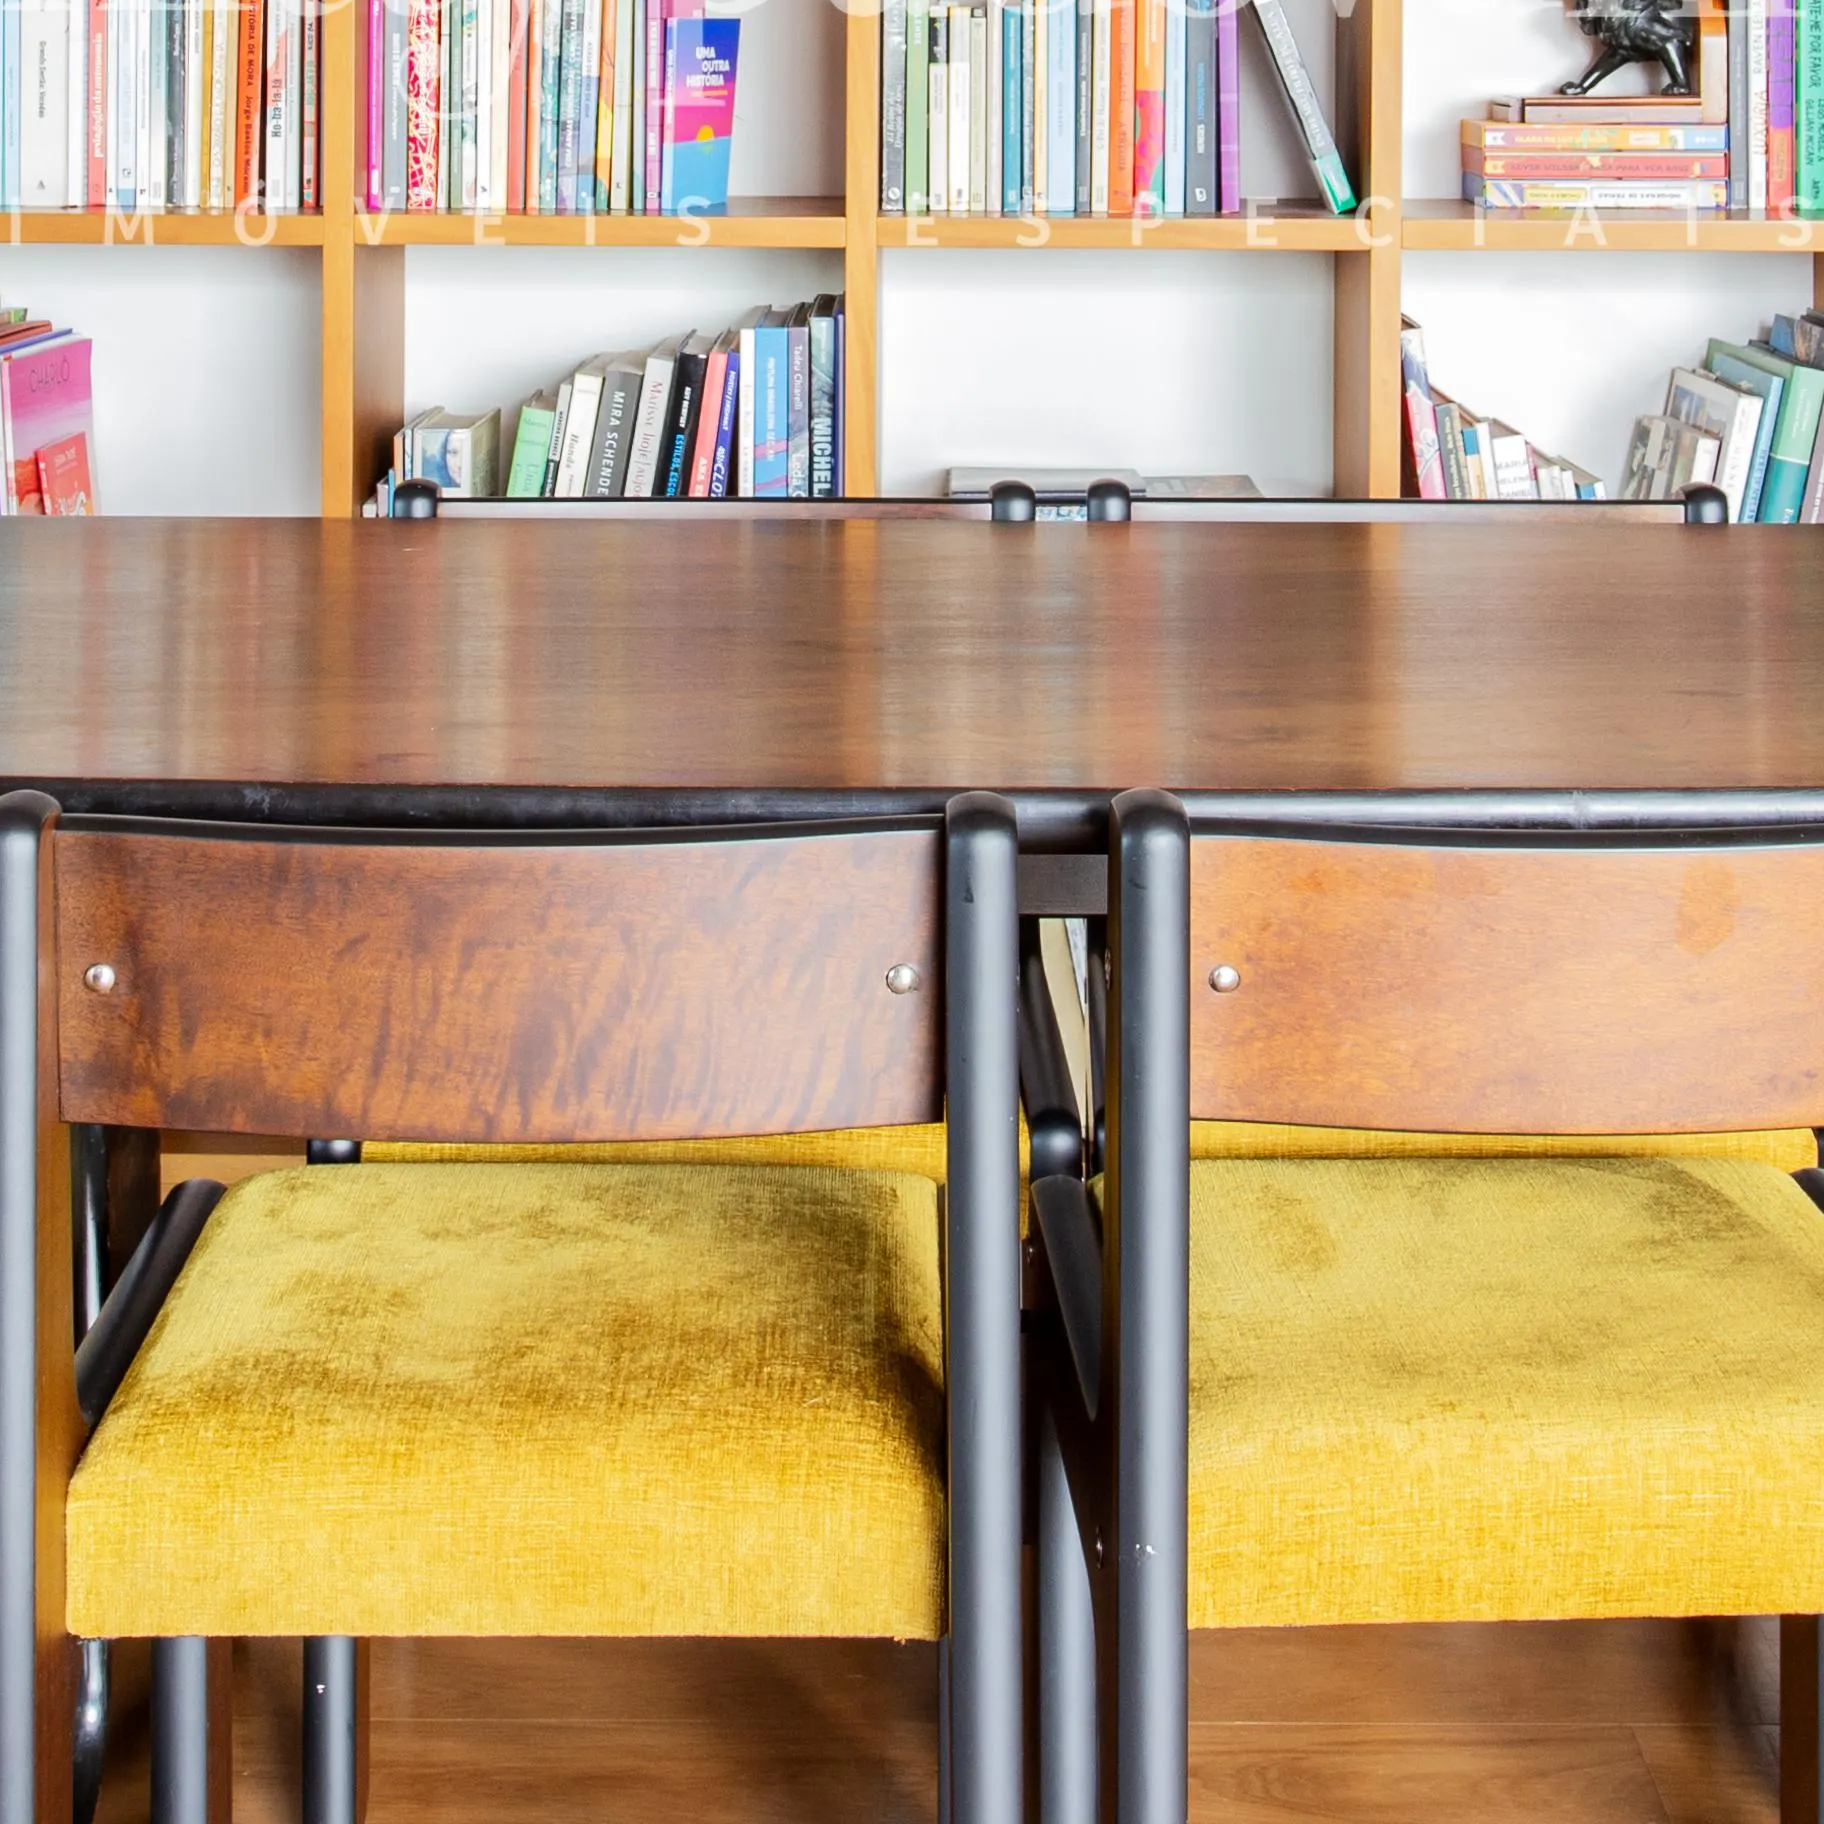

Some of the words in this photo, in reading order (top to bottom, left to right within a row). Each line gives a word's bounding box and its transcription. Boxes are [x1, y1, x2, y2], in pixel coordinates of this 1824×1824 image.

[38, 40, 47, 64] Grande
[247, 43, 257, 56] DE
[695, 45, 717, 59] UMA
[1751, 40, 1764, 69] RAVEN
[1808, 35, 1823, 54] POR
[247, 58, 257, 87] MORA
[687, 71, 725, 88] HISTÓRIA
[702, 59, 731, 72] OUTRA
[1808, 56, 1823, 89] FAVOR
[38, 91, 47, 118] Veredas
[243, 96, 254, 121] Jorge
[1804, 98, 1816, 133] GILLIAN
[243, 123, 254, 156] Bastos
[1804, 135, 1816, 166] MCCAIN
[29, 358, 71, 393] CHARLÔ
[793, 344, 803, 380] Tadeu
[611, 390, 626, 426] MIRA
[649, 379, 664, 428] Matisse
[597, 428, 619, 495] SCHENDE
[791, 453, 804, 486] Leda
